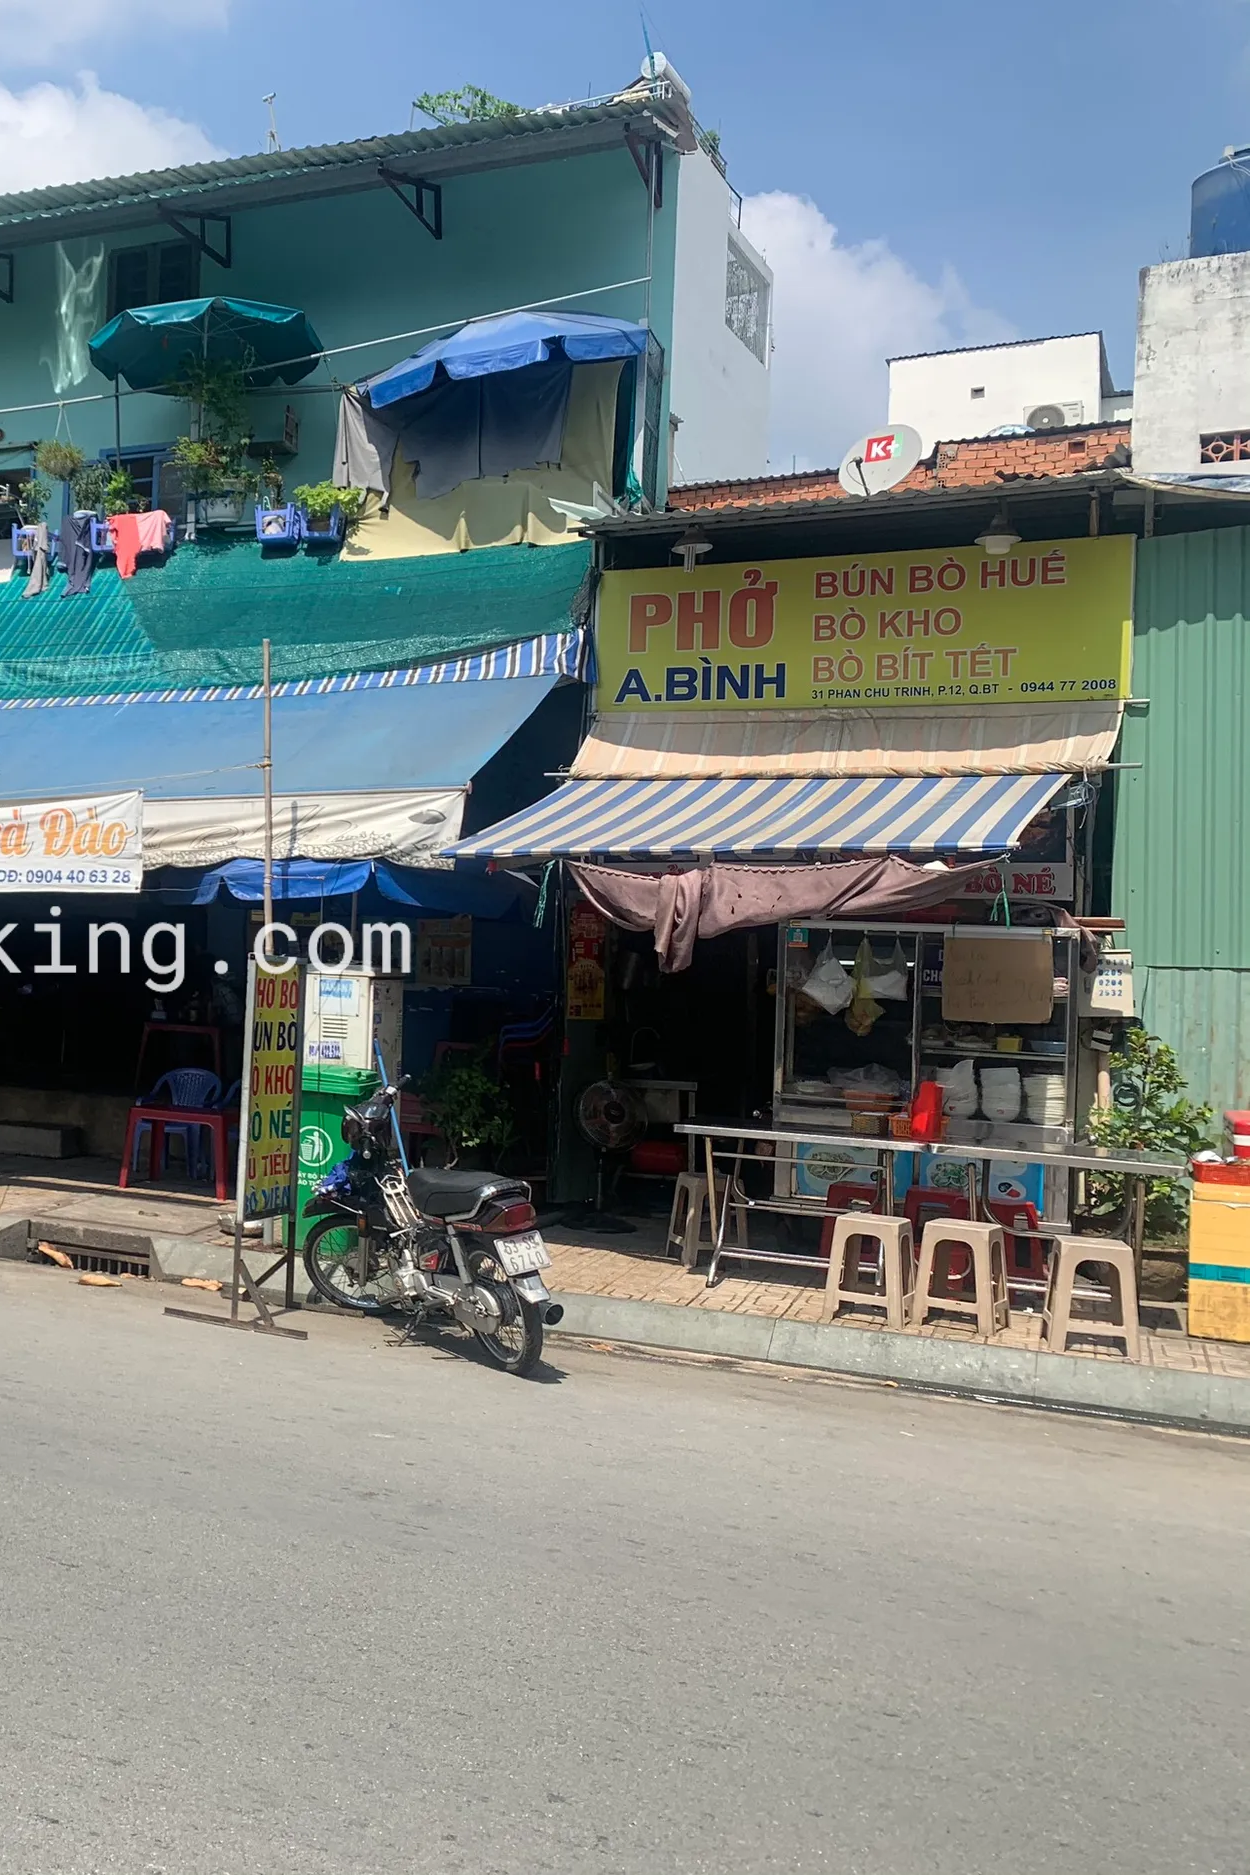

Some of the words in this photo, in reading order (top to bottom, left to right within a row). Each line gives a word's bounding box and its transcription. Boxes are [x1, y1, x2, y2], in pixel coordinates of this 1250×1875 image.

[870, 439, 899, 459] K+
[815, 563, 894, 599] BÚN
[908, 556, 967, 593] BÒ
[980, 549, 1066, 589] HUẾ
[628, 569, 778, 653] PHỞ
[813, 606, 866, 642] BÒ
[879, 607, 962, 639] KHO
[614, 656, 787, 703] A.BÌNH
[812, 649, 864, 683] BÒ
[876, 646, 934, 681] BÍT
[945, 643, 1018, 679] TẾT
[811, 689, 824, 700] 31
[827, 688, 861, 699] PHAN
[864, 687, 891, 698] CHU
[894, 686, 935, 698] TRINH,
[937, 685, 965, 697] P.12,
[968, 683, 1000, 695] Q.BT
[1020, 681, 1055, 693] 0944
[1060, 680, 1077, 691] 77
[1081, 678, 1117, 690] 2008
[39, 806, 138, 858] Đào
[26, 869, 62, 883] 0904
[66, 869, 85, 883] 40
[89, 869, 108, 883] 63
[112, 869, 131, 883] 28
[964, 866, 1002, 894] BÒ
[1012, 865, 1056, 895] NÉ
[256, 973, 276, 1009] HỞ
[279, 971, 299, 1009] BÒ
[253, 1012, 273, 1051] ÚN
[276, 1013, 298, 1051] BÒ
[252, 1057, 260, 1096] Ò
[264, 1064, 295, 1095] KHO
[252, 1102, 262, 1142] Ò
[269, 1101, 293, 1139] NÉ
[248, 1149, 257, 1180] Ủ
[261, 1144, 291, 1177] TIẾU
